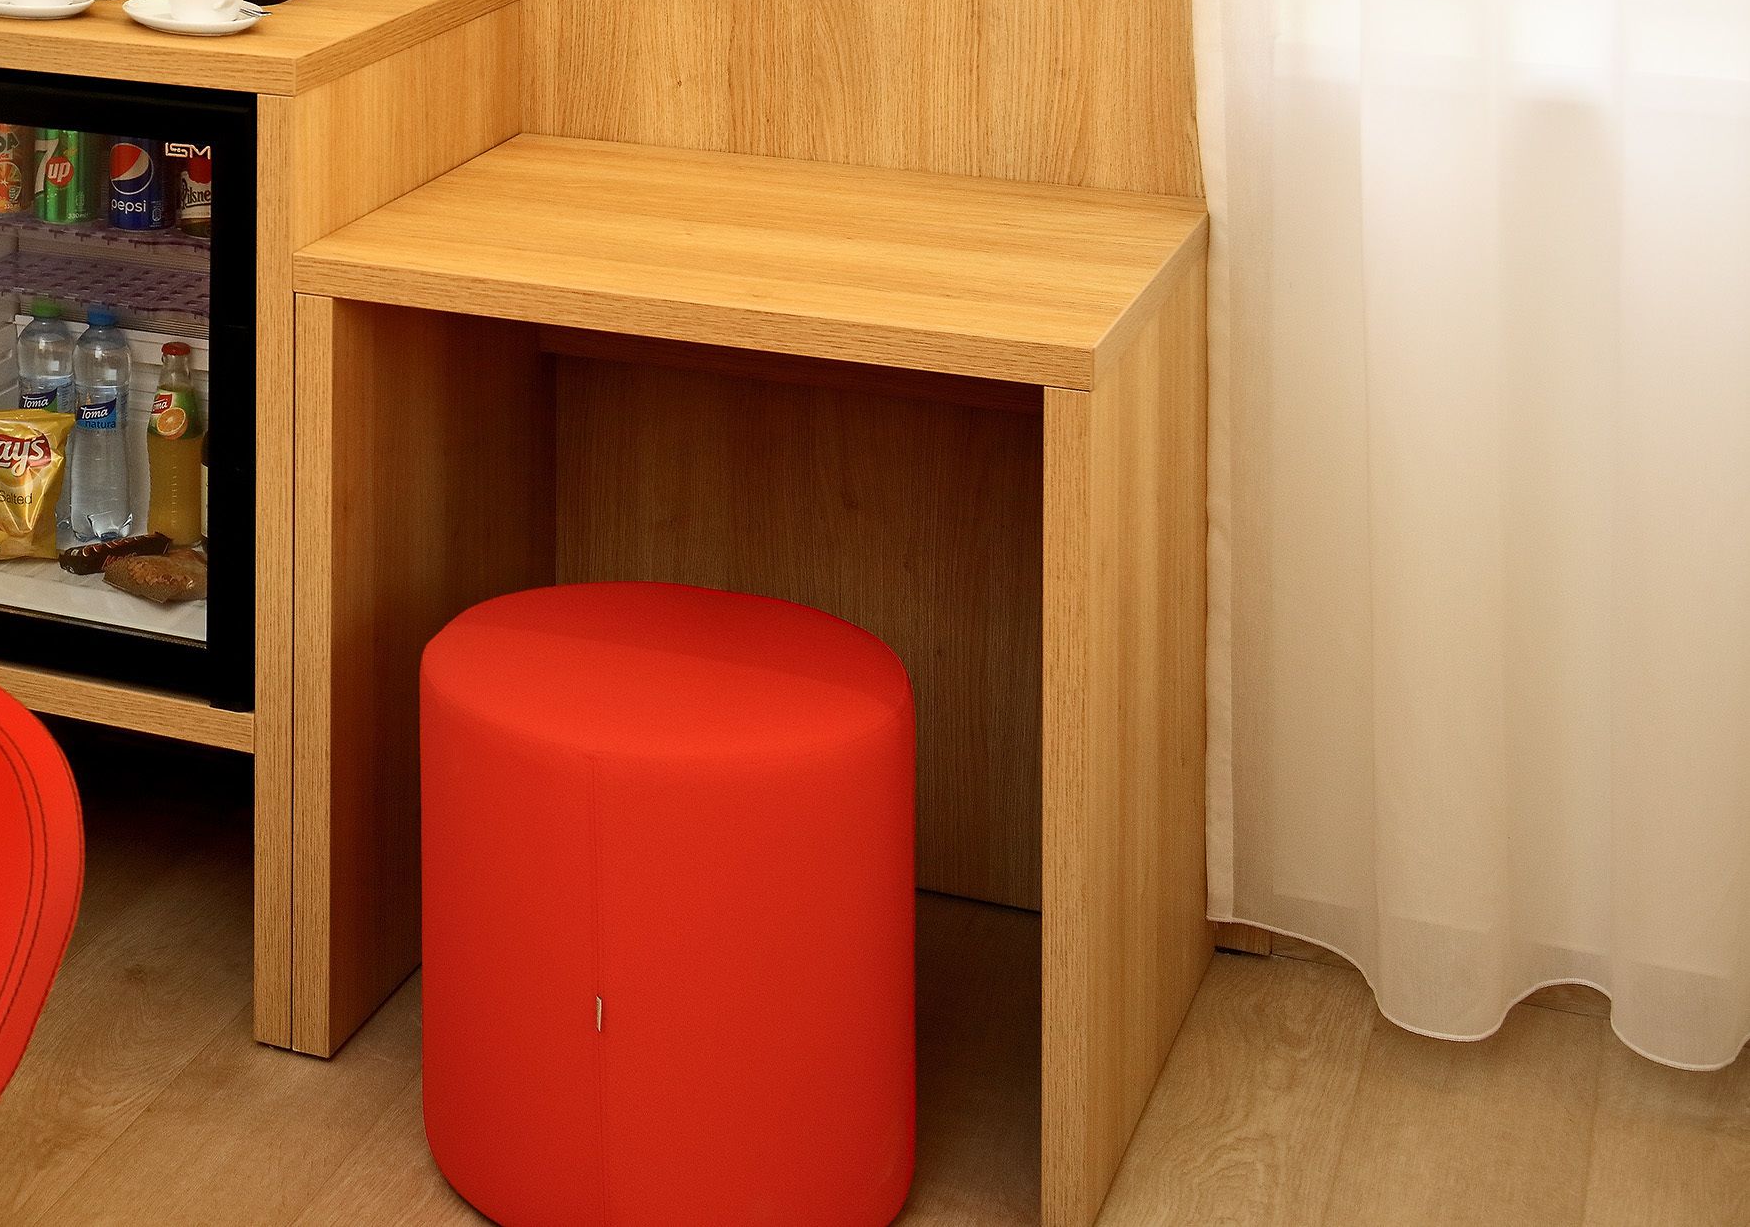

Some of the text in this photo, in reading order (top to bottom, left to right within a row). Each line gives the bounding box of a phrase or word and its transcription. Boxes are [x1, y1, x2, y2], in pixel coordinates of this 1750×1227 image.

[181, 177, 211, 211] Pilsne
[111, 199, 147, 214] pepsi
[22, 395, 49, 409] Toma
[80, 406, 109, 420] Toma
